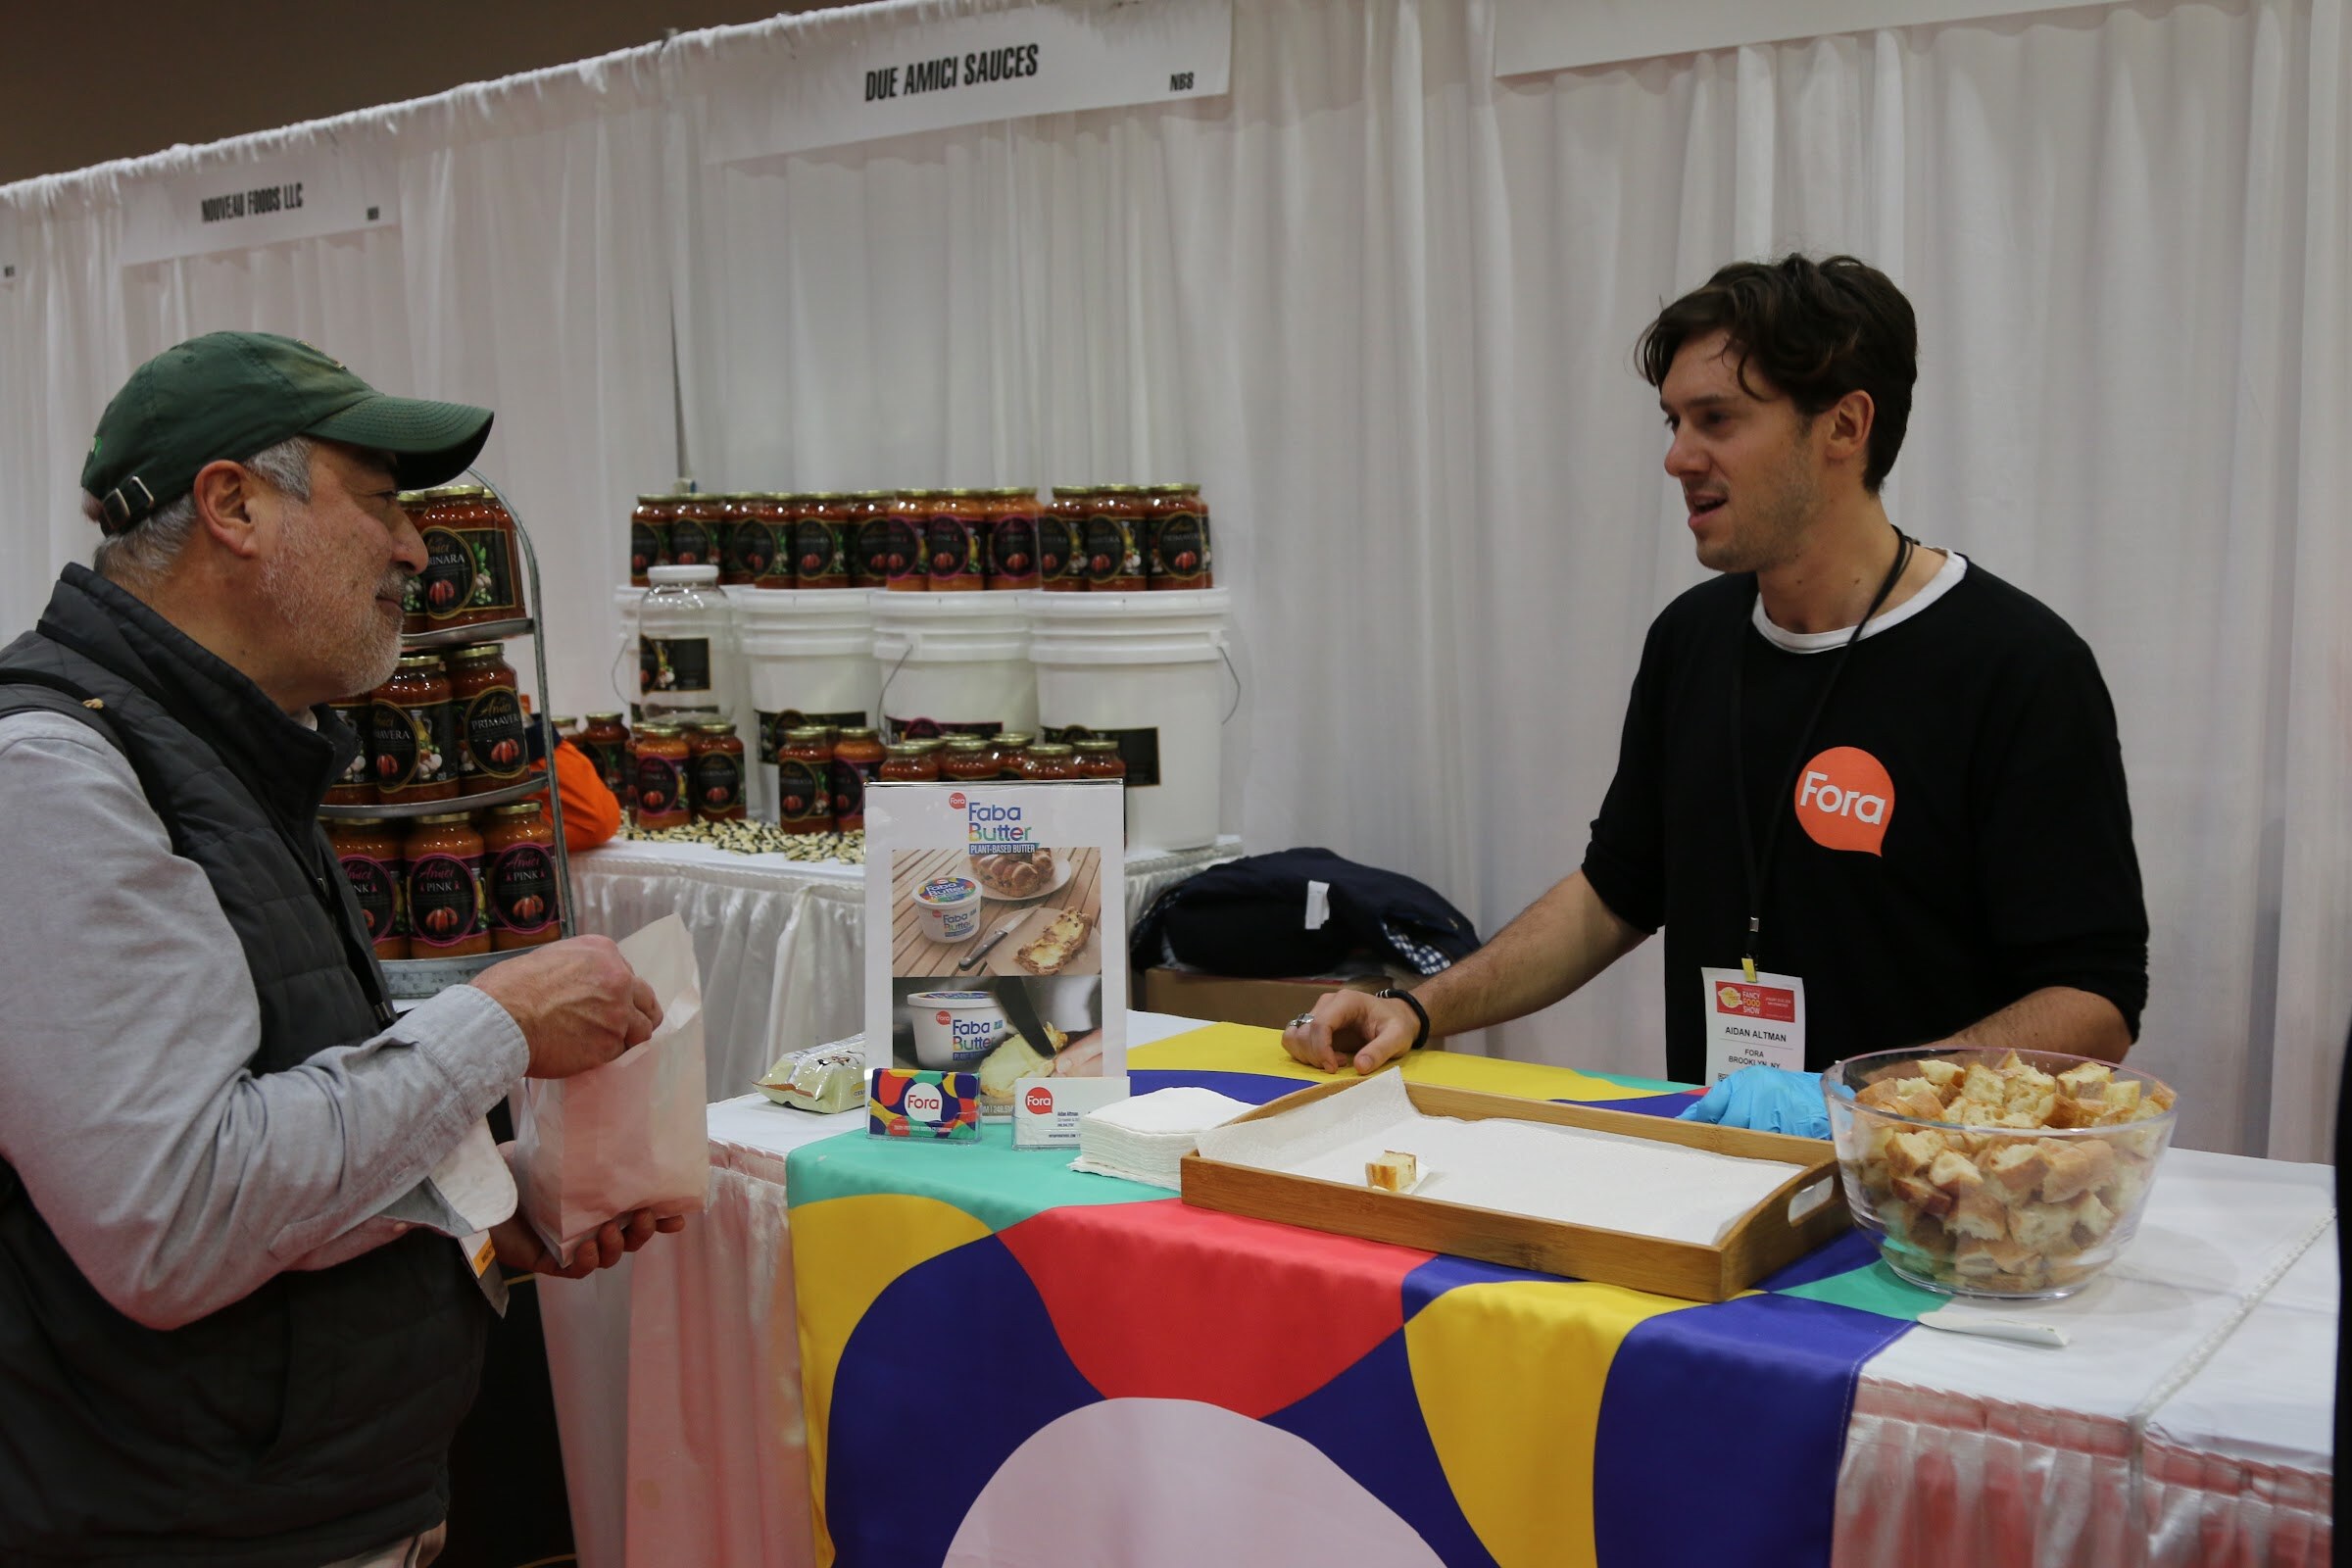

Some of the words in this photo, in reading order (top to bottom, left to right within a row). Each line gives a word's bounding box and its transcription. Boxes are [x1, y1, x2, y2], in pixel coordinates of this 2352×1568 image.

[865, 67, 899, 102] DUE
[904, 56, 957, 95] AMICI
[964, 44, 1039, 85] SAUCES
[202, 192, 244, 223] NOUVEAU
[248, 185, 280, 215] FOODS
[283, 182, 303, 209] LLC
[1799, 770, 1886, 825] Fora
[968, 802, 1021, 821] Faba
[968, 822, 1032, 842] Butter
[970, 844, 1011, 855] PLANT-BASED
[1012, 844, 1036, 854] BUTTER
[514, 870, 539, 882] PINK
[427, 882, 452, 893] PINK
[925, 883, 957, 893] Faba
[943, 913, 968, 923] Faba
[1742, 999, 1761, 1007] FOOD
[1742, 1005, 1761, 1015] SHOW
[953, 1019, 990, 1035] Faba
[1725, 1026, 1750, 1038] AIDAN
[1752, 1030, 1787, 1043] ALTMAN
[1744, 1049, 1764, 1057] FORA
[907, 1095, 939, 1109] Fora
[1027, 1095, 1052, 1107] Fora
